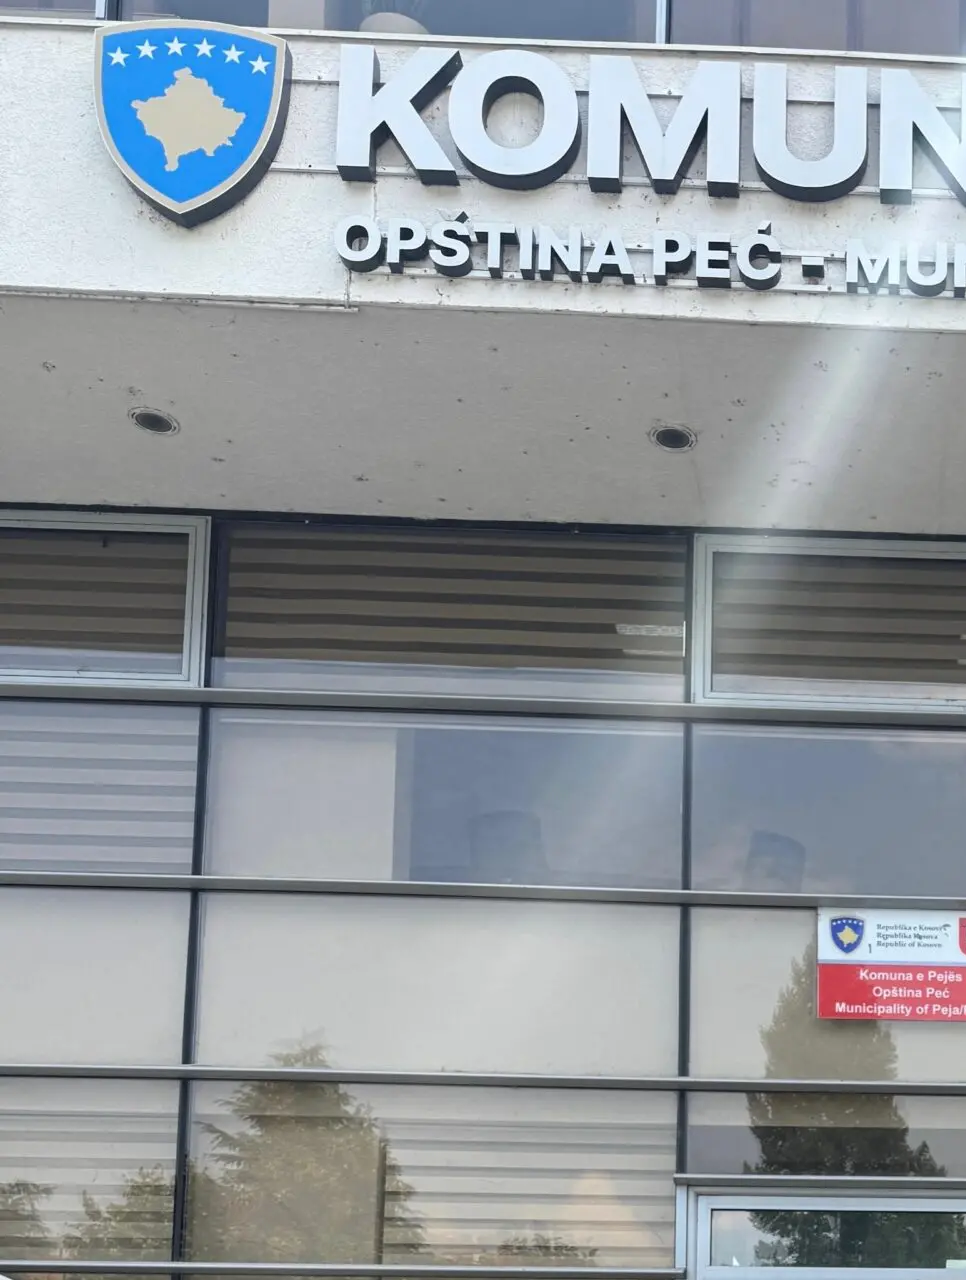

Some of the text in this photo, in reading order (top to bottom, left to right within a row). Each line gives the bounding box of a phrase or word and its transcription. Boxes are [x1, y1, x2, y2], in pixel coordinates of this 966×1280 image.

[652, 221, 782, 289] PEĆ
[859, 969, 963, 985] Komuna e Pejës
[872, 986, 950, 999] Opština Peć
[835, 1002, 912, 1016] Municipality
[915, 1004, 929, 1015] of
